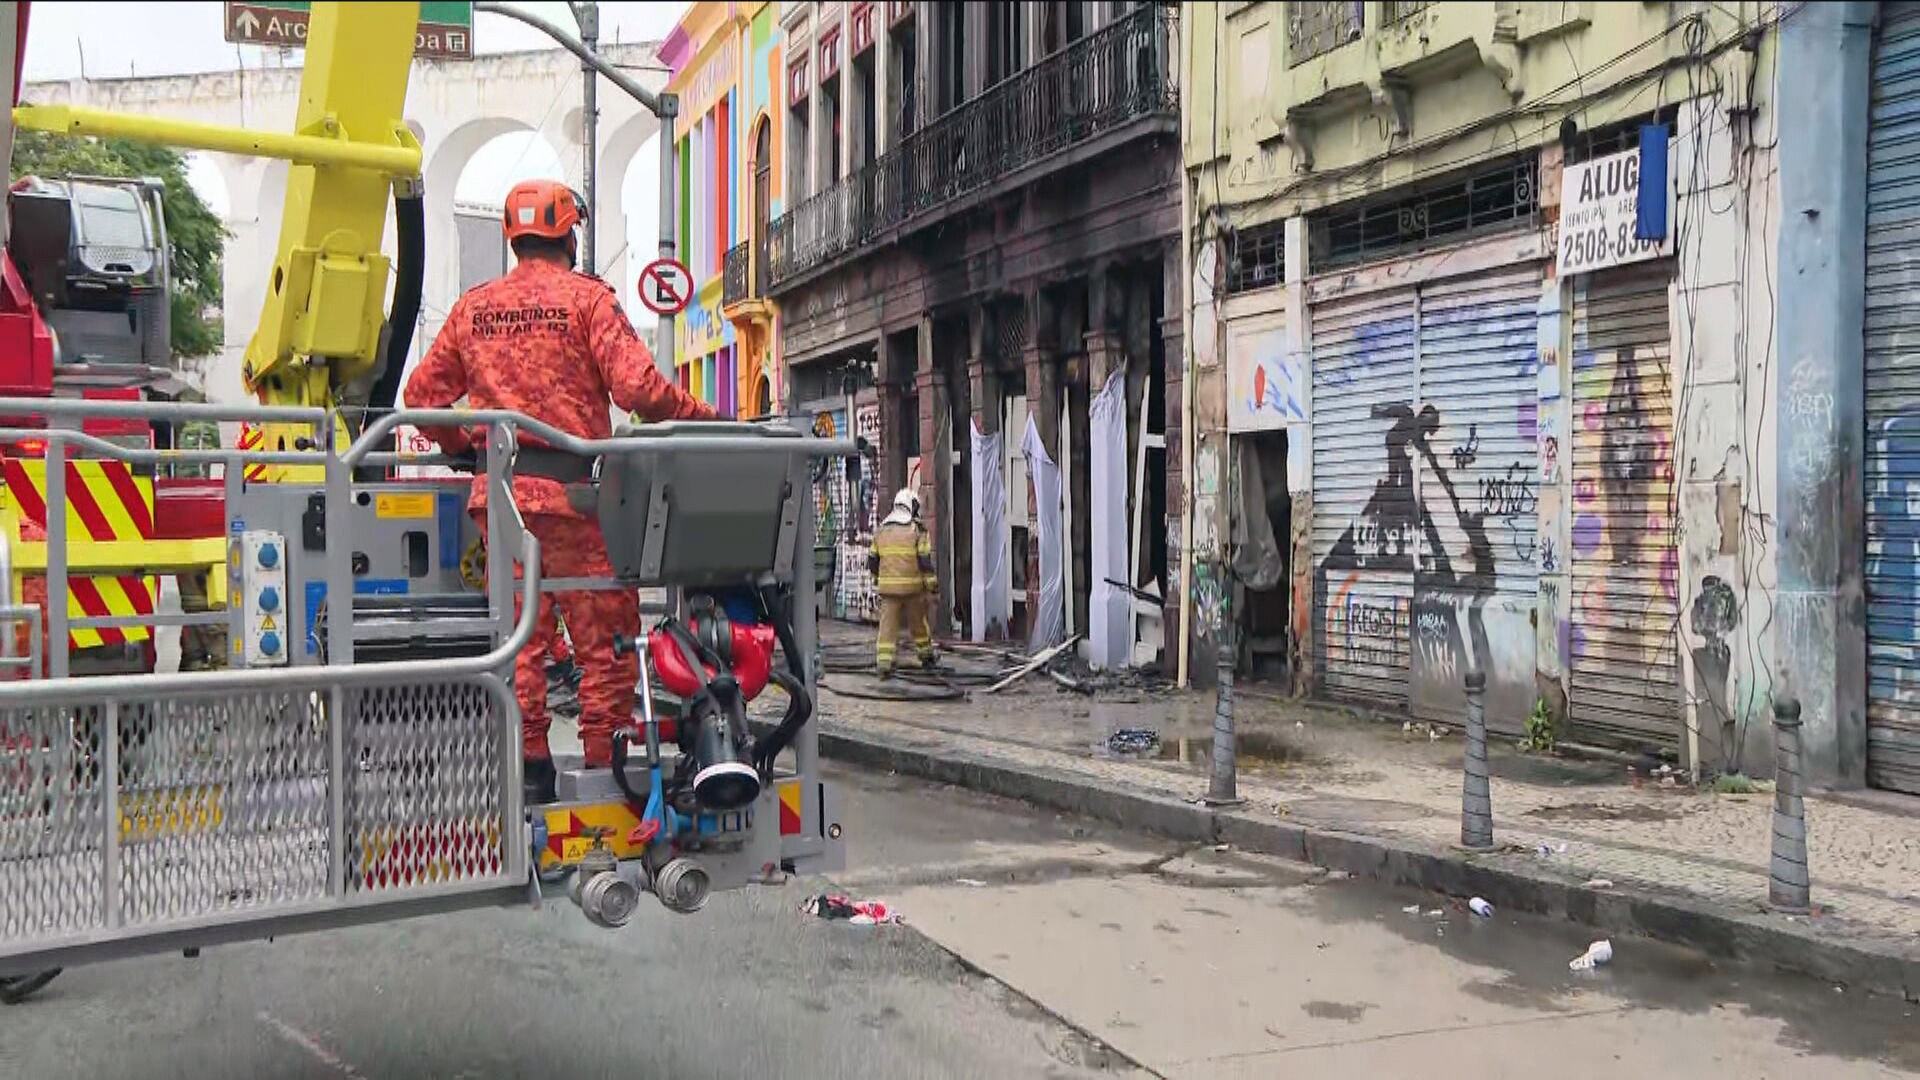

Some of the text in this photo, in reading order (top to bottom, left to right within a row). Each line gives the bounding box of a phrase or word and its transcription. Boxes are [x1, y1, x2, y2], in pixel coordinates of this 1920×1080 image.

[1579, 154, 1638, 203] ALUG
[656, 271, 676, 303] E
[472, 307, 569, 326] BOMBEIROS
[472, 322, 532, 337] MILITAR
